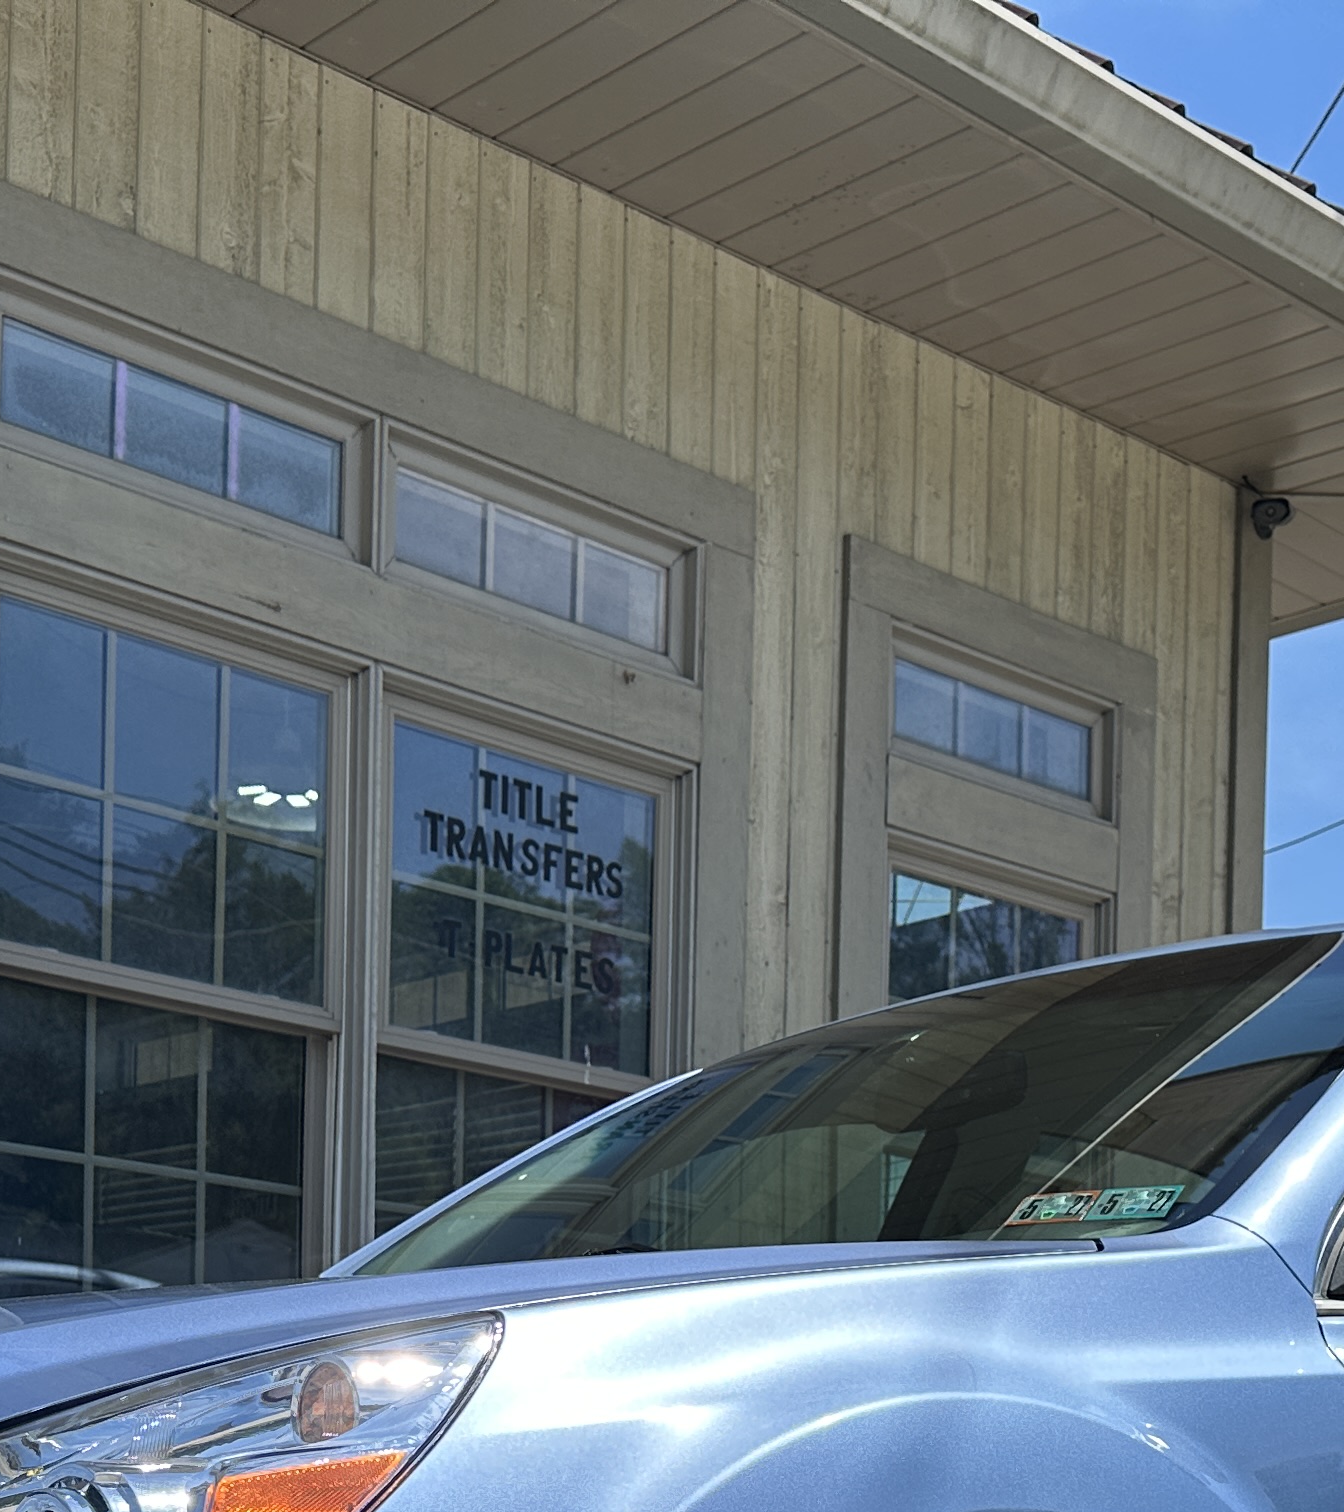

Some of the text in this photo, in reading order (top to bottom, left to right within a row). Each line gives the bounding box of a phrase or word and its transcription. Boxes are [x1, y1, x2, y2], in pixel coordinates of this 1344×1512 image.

[478, 769, 579, 834] TITLE
[423, 809, 623, 899] TRANSFERS
[1018, 1194, 1094, 1220] 5 27
[1099, 1189, 1176, 1216] 5 27
